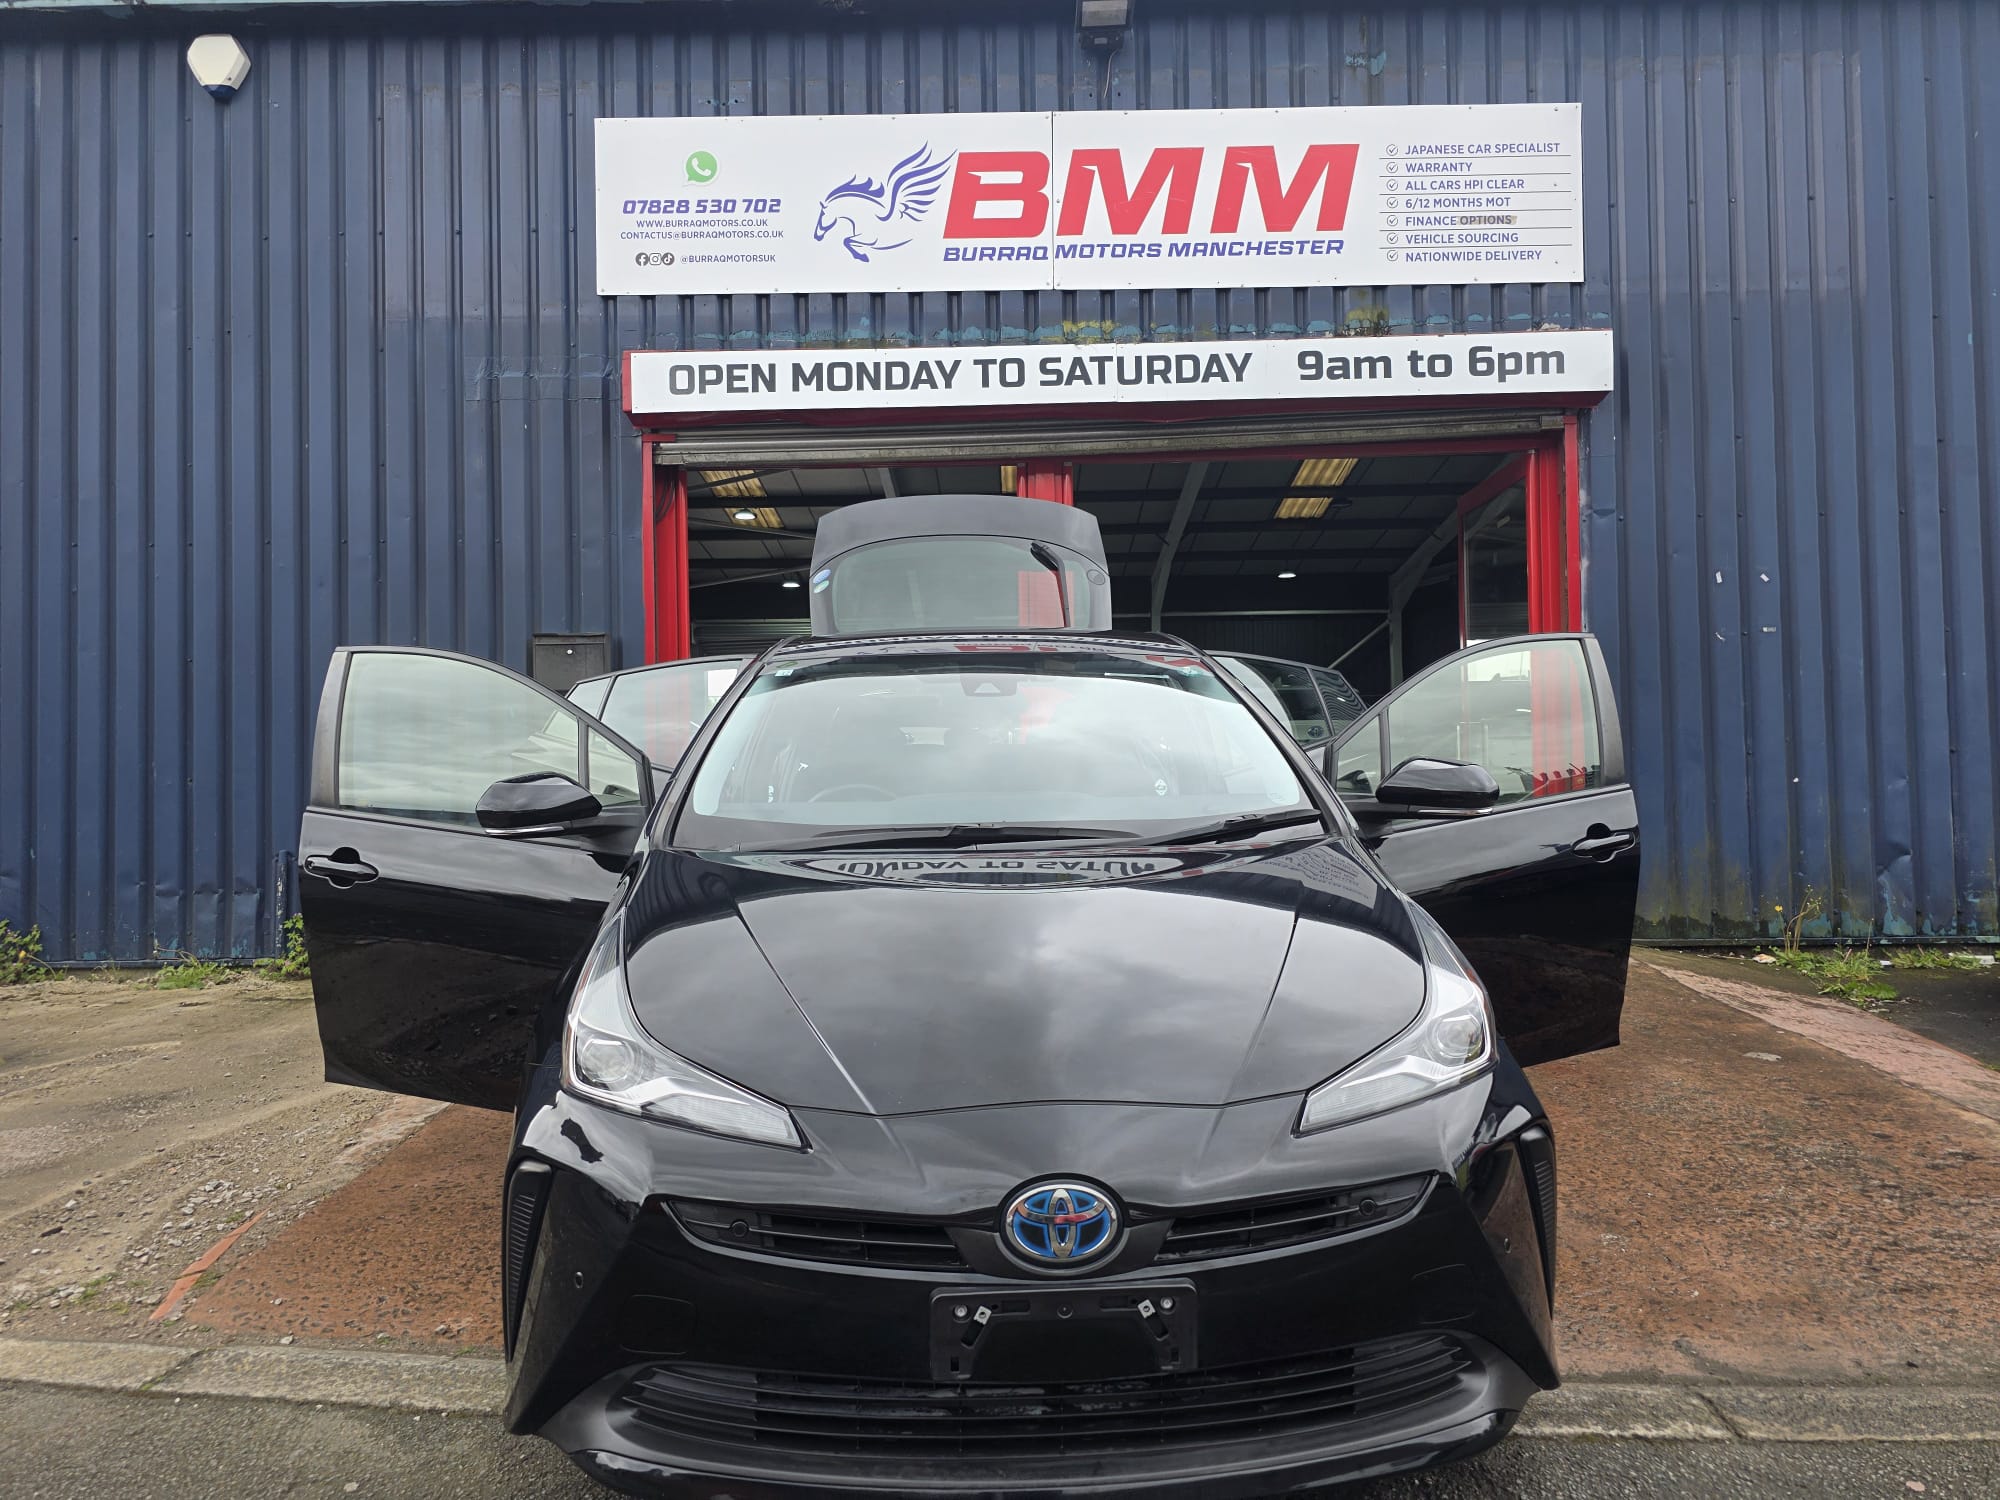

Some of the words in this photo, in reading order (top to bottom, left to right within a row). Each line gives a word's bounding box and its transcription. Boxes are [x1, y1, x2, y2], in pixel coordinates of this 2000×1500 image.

[1405, 145, 1464, 154] JAPANESE
[1468, 144, 1491, 153] CAR
[1495, 143, 1560, 153] SPECIALIST
[1406, 162, 1472, 172] WARRANTY
[1405, 181, 1427, 190] ALL
[1430, 180, 1461, 190] CARS
[1465, 180, 1482, 189] HPI
[1487, 179, 1524, 189] CLEAR
[943, 143, 1360, 239] BMM
[623, 200, 689, 214] 07828
[695, 199, 736, 213] 530
[742, 199, 781, 213] 702
[1406, 198, 1430, 209] 6/12
[1434, 198, 1482, 208] MONTHS
[1486, 197, 1511, 207] MOT
[635, 219, 768, 229] WWW.BURRAQMOTORS.CO.UK
[1406, 216, 1457, 226] FINANCE
[1460, 215, 1511, 225] OPTIONS
[620, 230, 784, 240] CONTACTUS@BURRAQMOTORS.CO.UK
[1406, 234, 1454, 244] VEHICLE
[1458, 233, 1518, 243] SOURCING
[944, 246, 1048, 261] BURRAQ
[1055, 243, 1162, 259] MOTORS
[1168, 240, 1344, 257] MANCHESTER
[1406, 251, 1482, 262] NATIONWIDE
[1486, 250, 1542, 260] DELIVERY
[680, 254, 776, 264] @BURRAQMOTORSUK
[669, 363, 776, 395] OPEN
[792, 360, 961, 392] MONDAY
[973, 358, 1025, 388] TO
[1039, 353, 1252, 386] SATURDAY
[1298, 351, 1392, 380] 9am
[1407, 350, 1452, 378] to
[1469, 346, 1564, 382] 6pm
